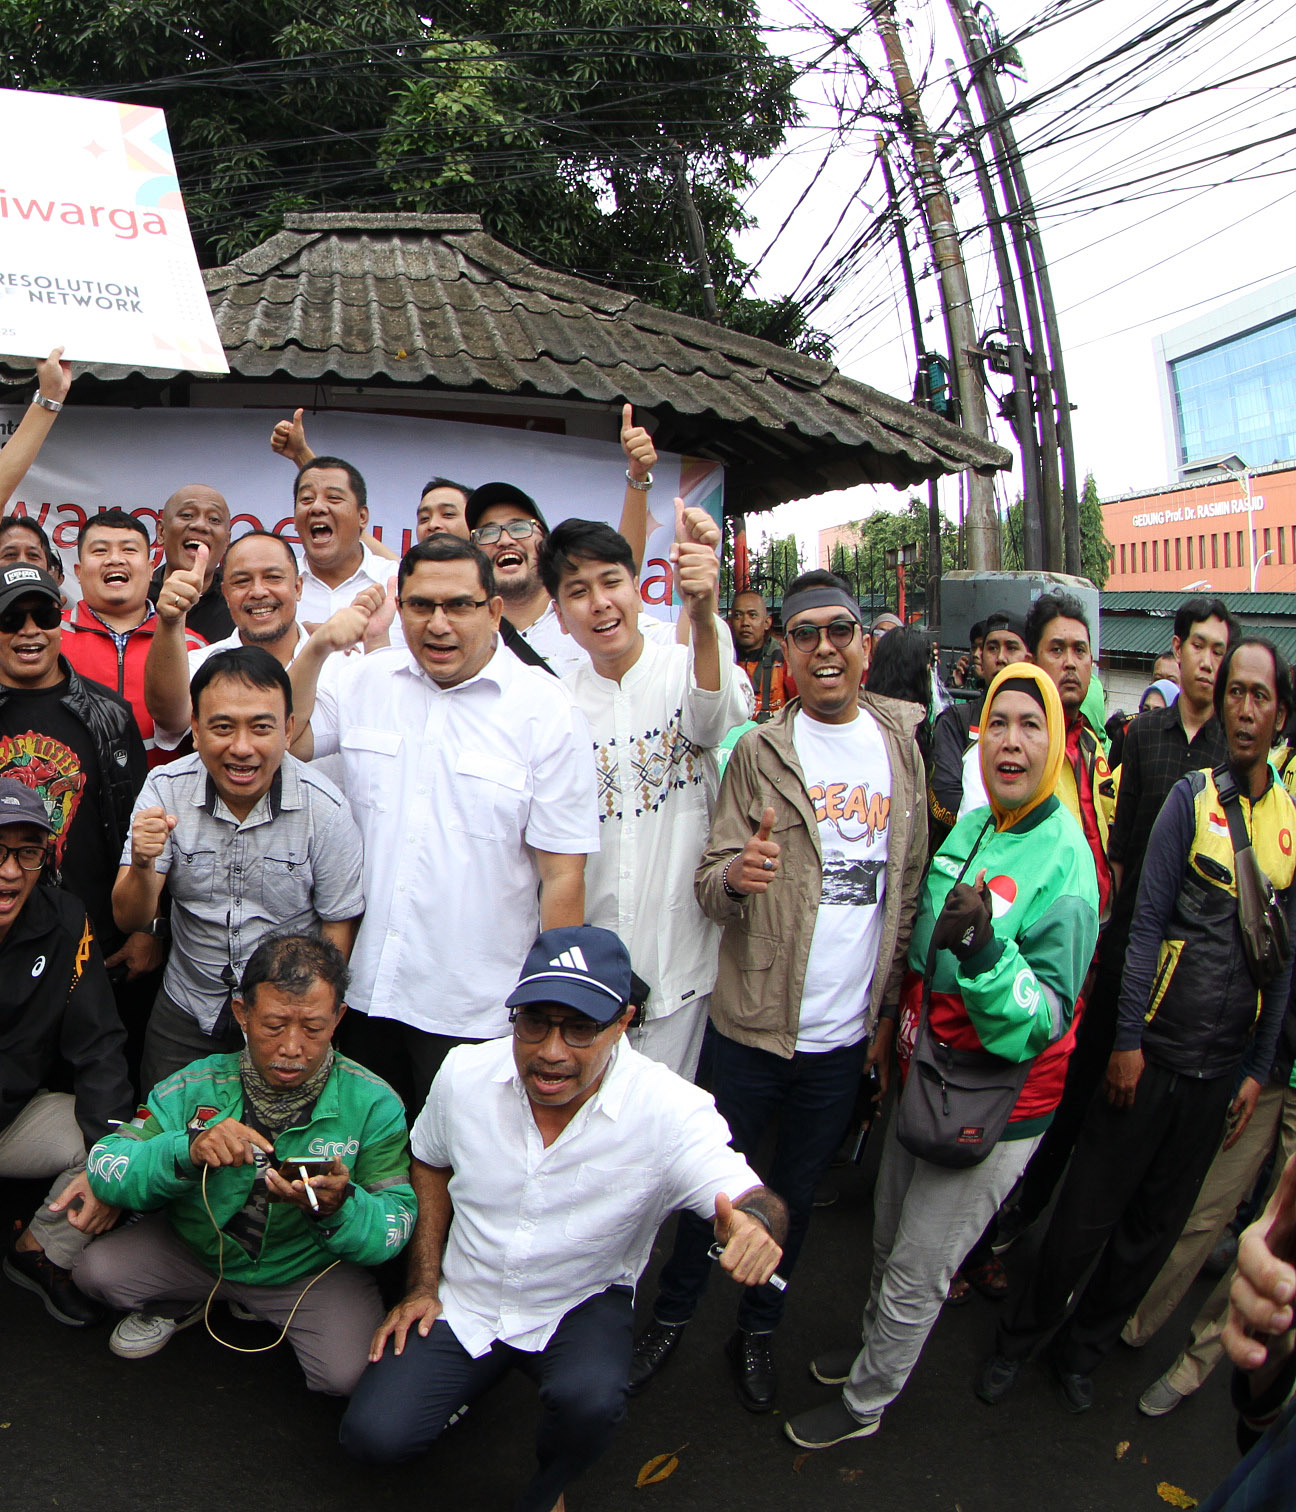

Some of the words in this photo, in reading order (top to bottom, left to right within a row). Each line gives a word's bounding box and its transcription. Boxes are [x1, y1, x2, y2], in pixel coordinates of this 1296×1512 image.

[29, 290, 143, 313] NETWORK
[1133, 513, 1164, 527] GEDUNG
[1165, 509, 1184, 522] Prof.
[1185, 507, 1196, 520] Dr.
[1197, 502, 1230, 518] RASMIN
[308, 1136, 360, 1157] Grab
